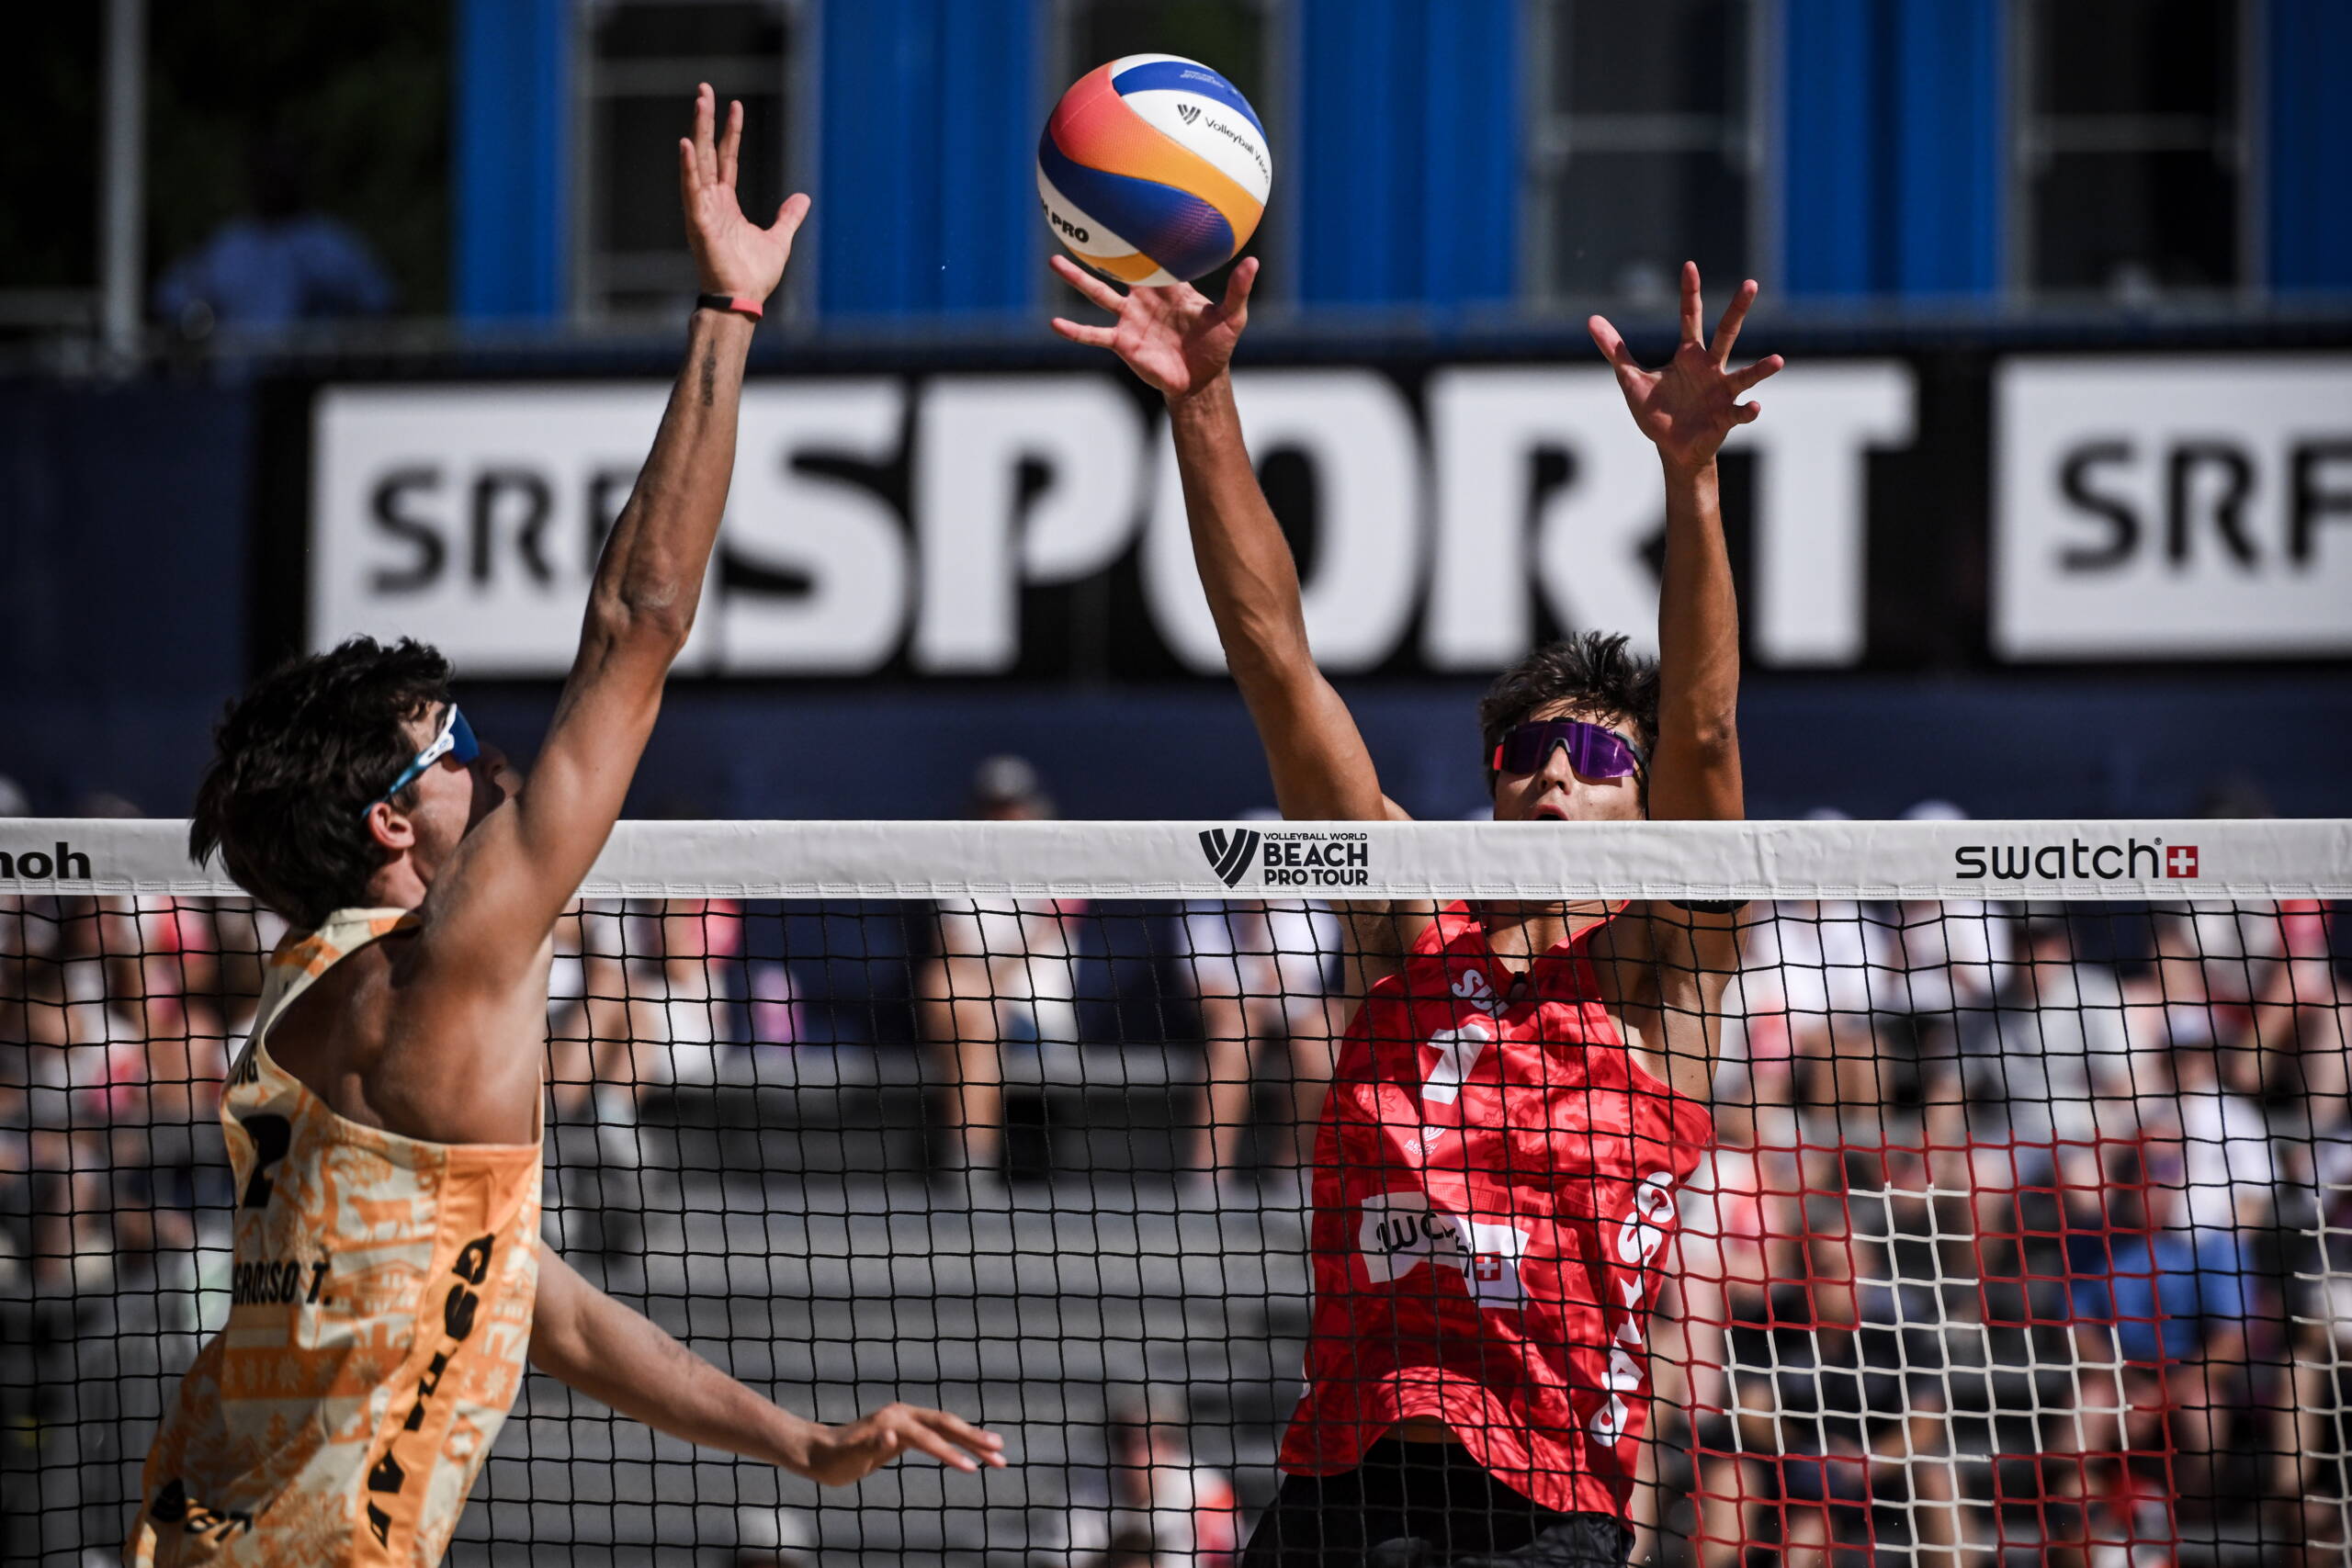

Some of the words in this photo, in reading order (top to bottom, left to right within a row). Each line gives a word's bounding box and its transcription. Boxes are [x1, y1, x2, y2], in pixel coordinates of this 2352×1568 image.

[1205, 117, 1255, 154] Volleyball
[1052, 211, 1090, 243] PRO
[718, 368, 1920, 678] SPORT
[2056, 438, 2352, 575] SRF
[1263, 832, 1328, 840] VOLLEYBALL
[1329, 832, 1368, 840] WORLD
[1263, 842, 1368, 866] BEACH
[1264, 869, 1308, 886] PRO
[1309, 869, 1368, 886] TOUR
[1422, 1022, 1489, 1105] 1
